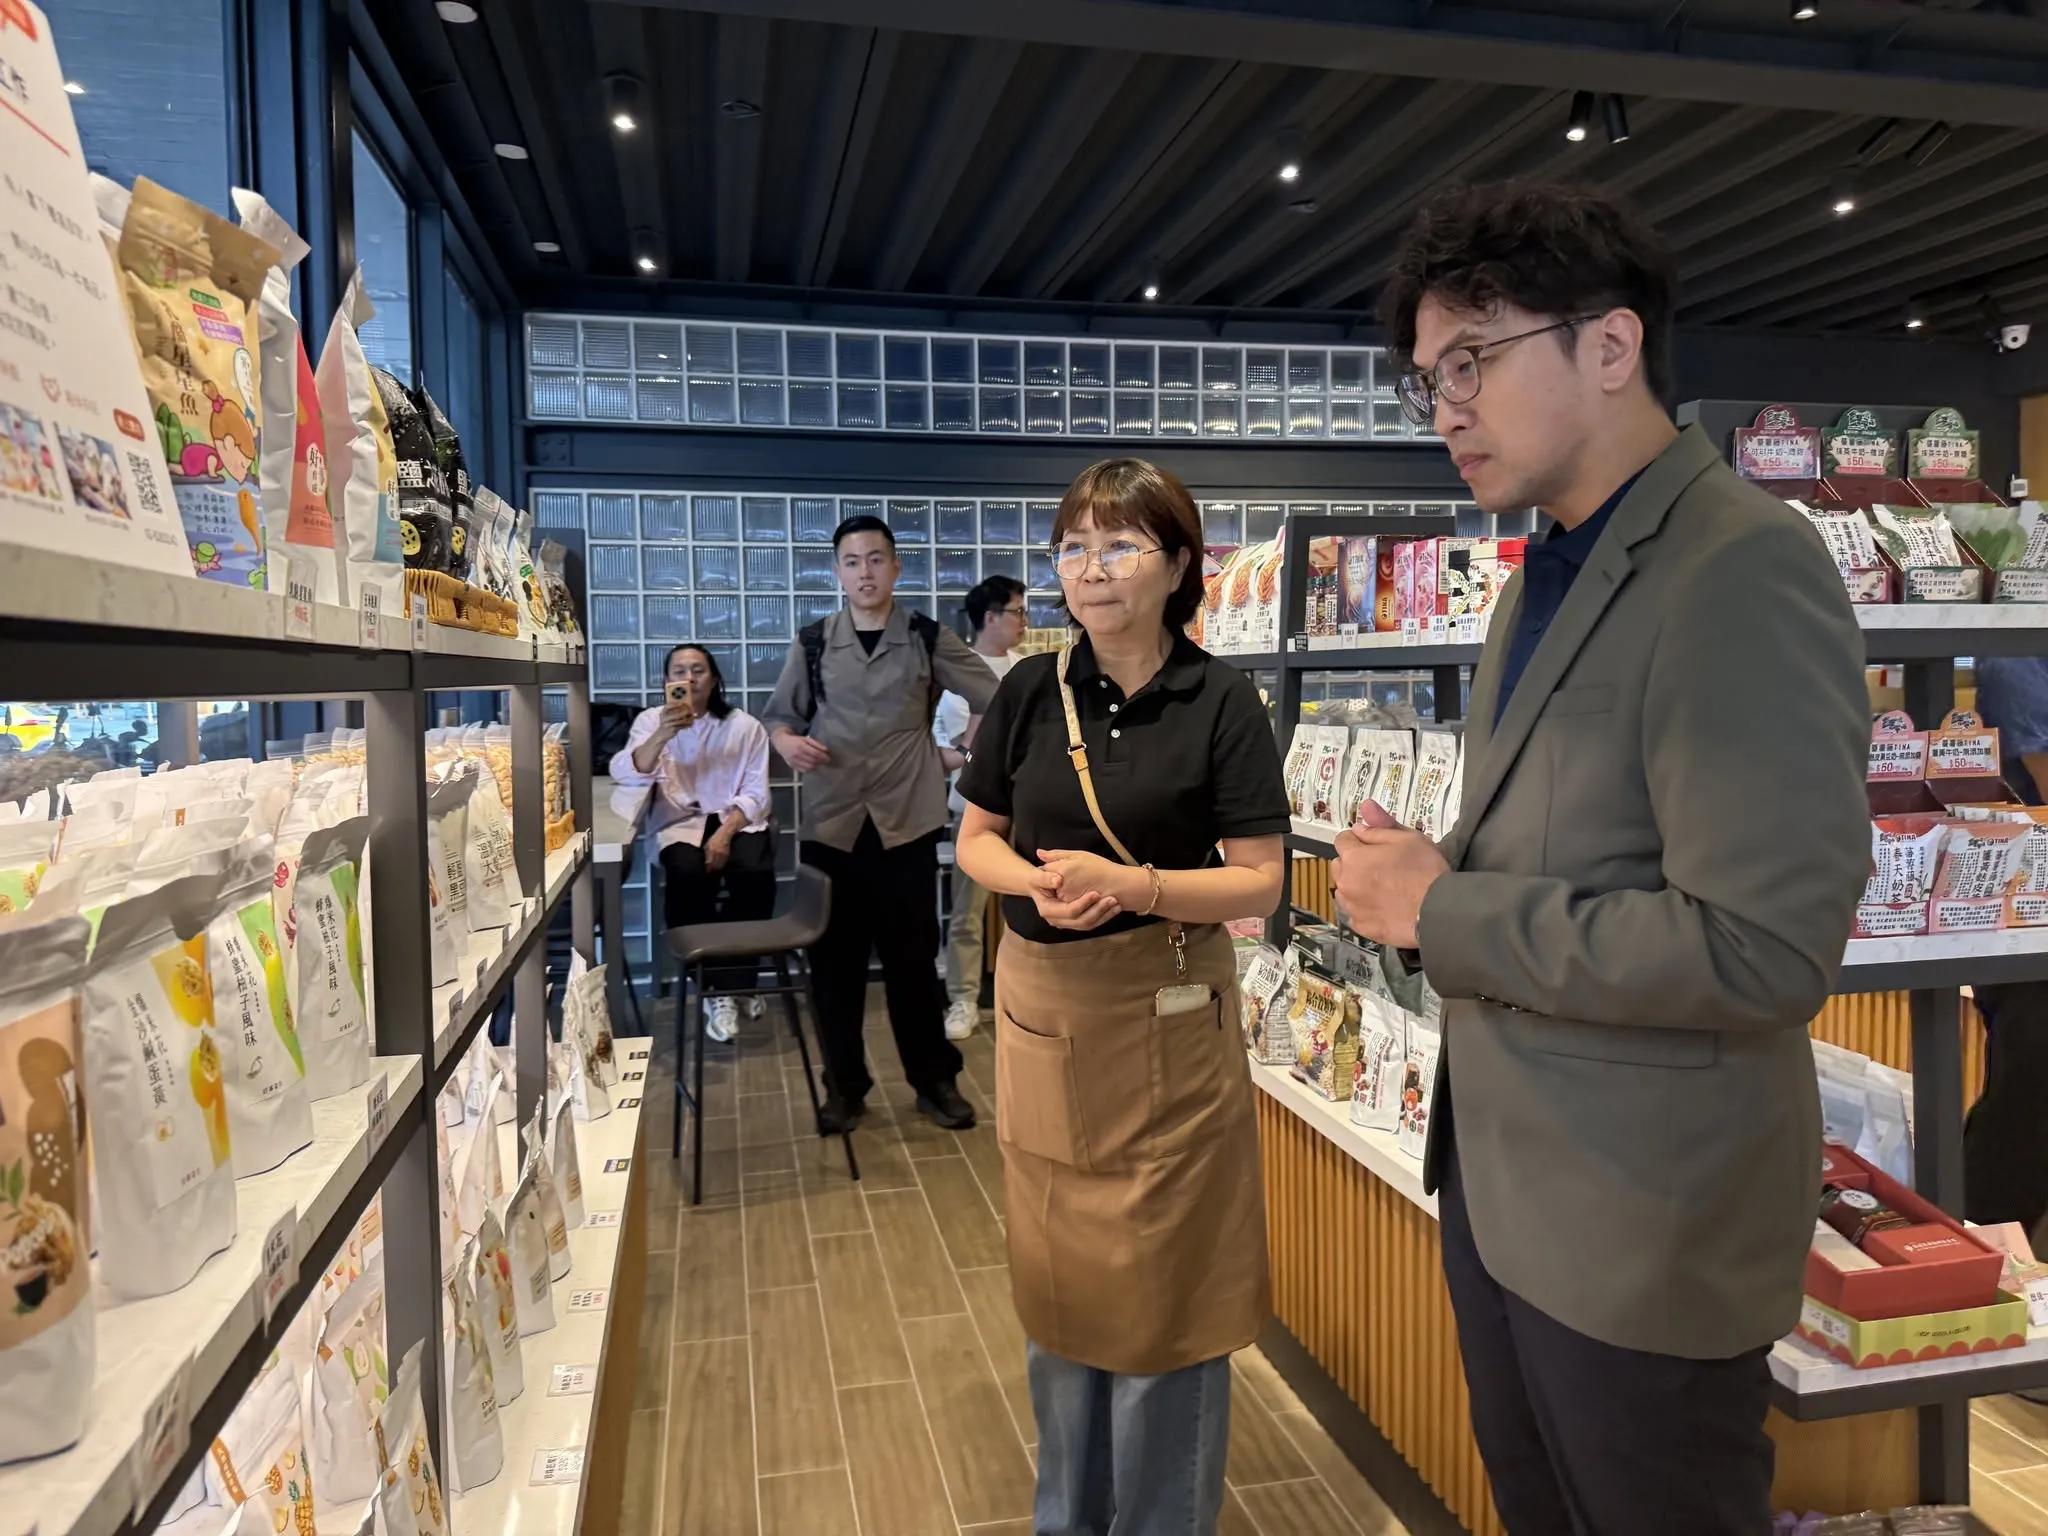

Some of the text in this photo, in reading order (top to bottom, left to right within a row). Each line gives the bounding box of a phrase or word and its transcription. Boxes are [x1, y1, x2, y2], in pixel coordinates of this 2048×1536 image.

[225, 940, 257, 1046] 蜂蜜柚子風味
